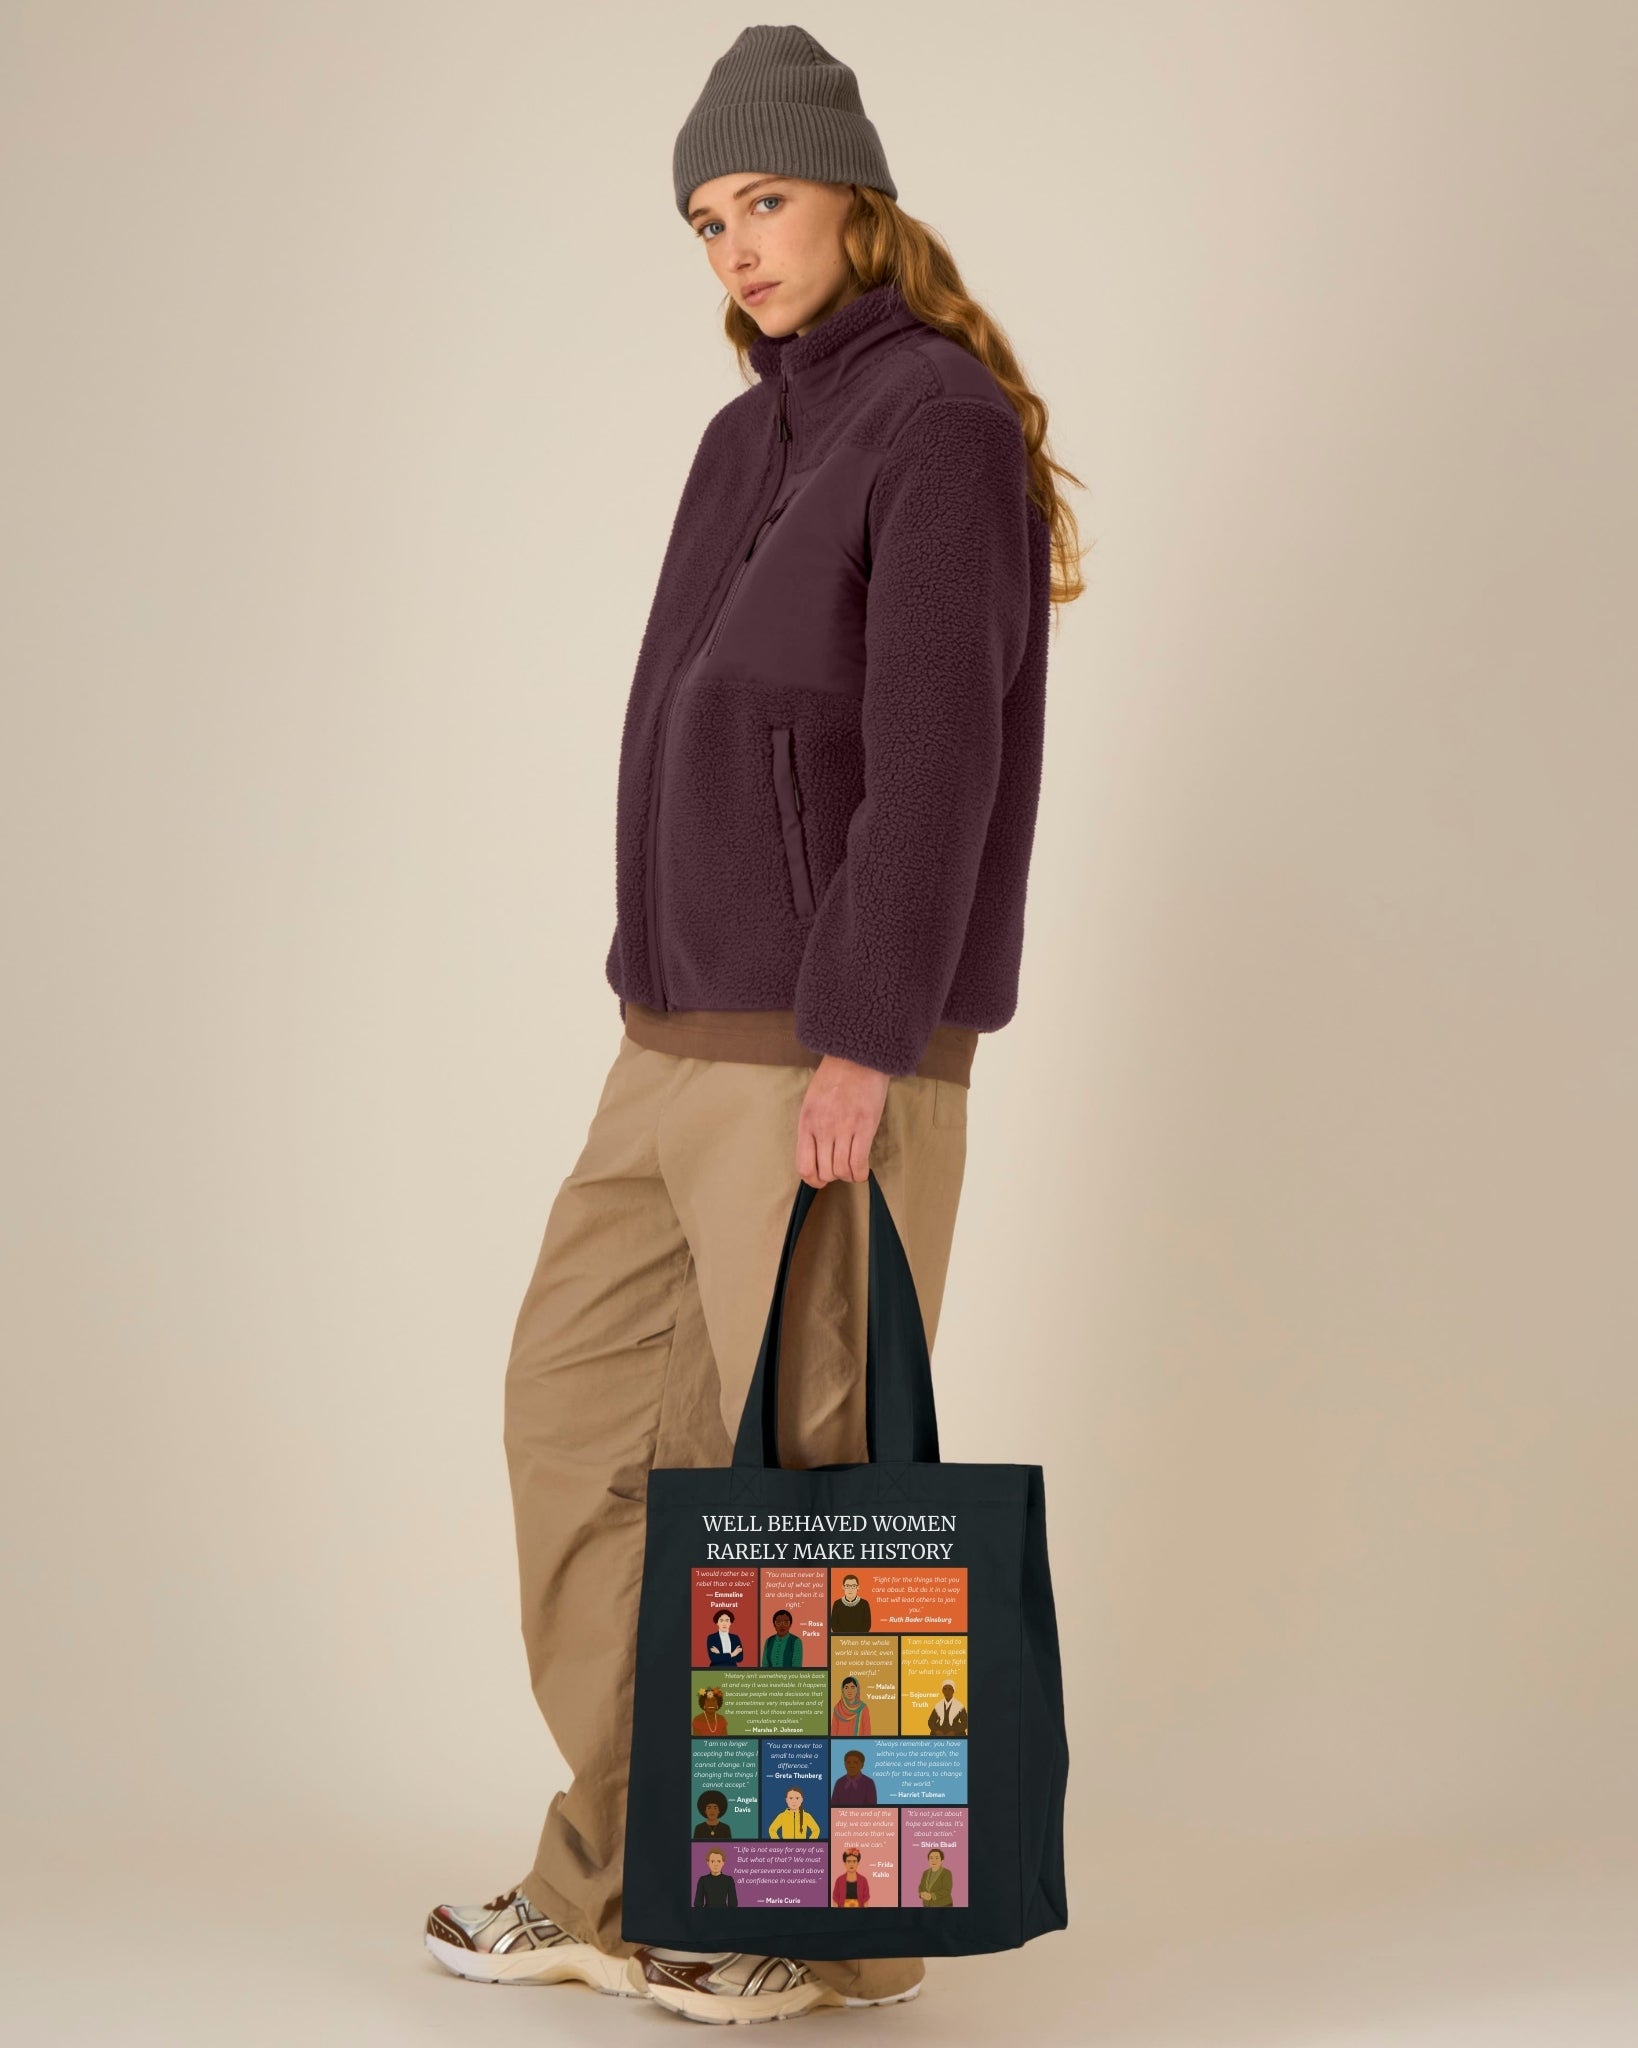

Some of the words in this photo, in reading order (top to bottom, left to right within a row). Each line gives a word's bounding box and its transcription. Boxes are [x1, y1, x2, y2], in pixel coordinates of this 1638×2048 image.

[702, 1515, 762, 1532] WELL
[768, 1515, 867, 1532] BEHAVED
[871, 1515, 956, 1532] WOMEN
[707, 1543, 789, 1560] RARELY
[793, 1543, 855, 1560] MAKE
[860, 1543, 954, 1560] HISTORY
